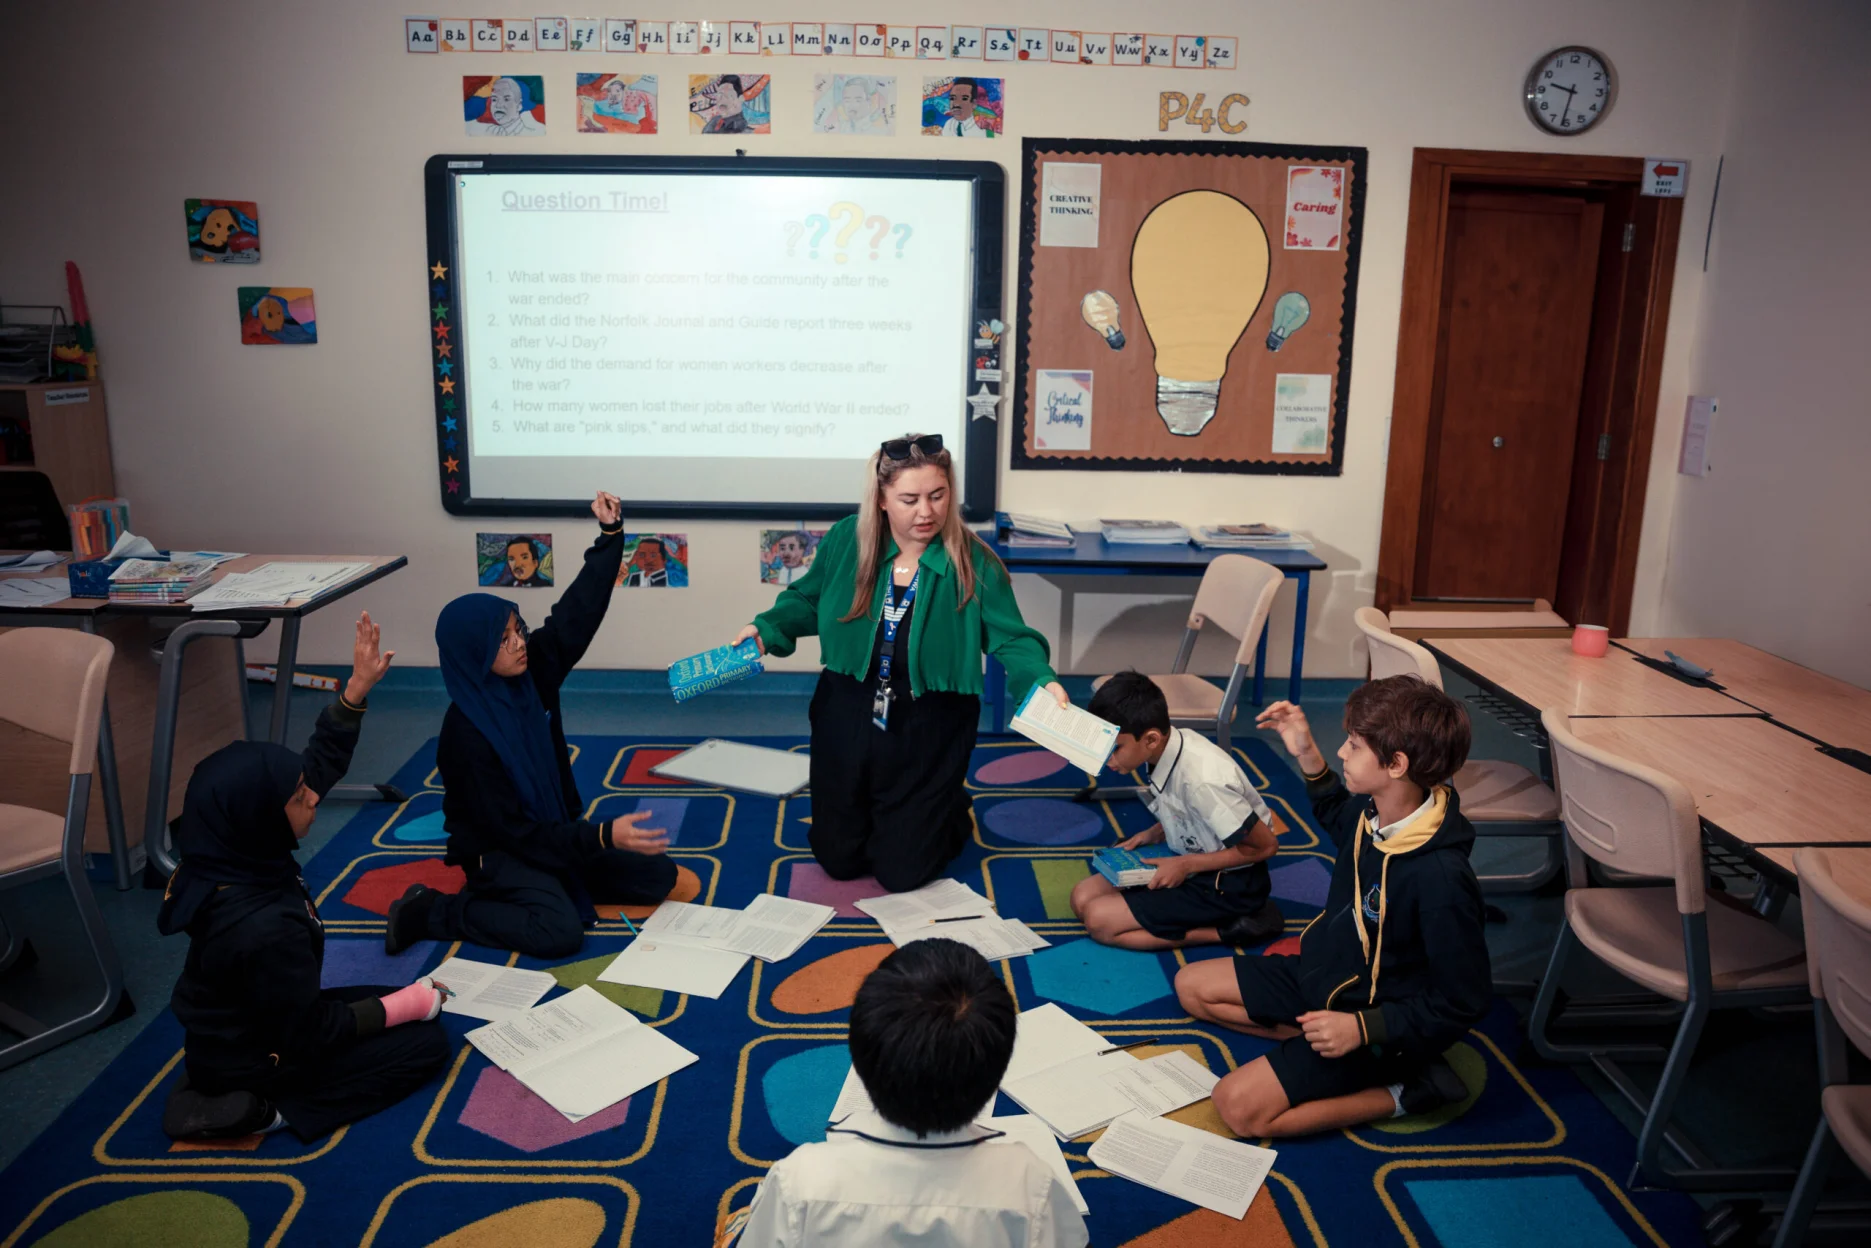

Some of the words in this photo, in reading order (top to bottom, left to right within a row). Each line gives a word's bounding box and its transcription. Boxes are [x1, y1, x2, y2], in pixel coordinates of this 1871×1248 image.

[1159, 91, 1250, 134] P4C
[502, 191, 600, 211] Question
[609, 192, 668, 210] Time!
[1049, 195, 1093, 203] CREATIVE
[1049, 206, 1093, 215] THINKING
[1293, 201, 1337, 215] Caring
[486, 271, 499, 284] 1.
[508, 271, 545, 284] What
[549, 273, 576, 284] was
[580, 271, 602, 284] the
[607, 272, 640, 284] main
[704, 272, 723, 284] for
[726, 273, 748, 285] the
[752, 273, 828, 289] community
[832, 274, 863, 287] after
[867, 275, 889, 287] the
[508, 295, 534, 305] war
[538, 292, 590, 305] ended?
[487, 315, 499, 327] 2.
[509, 314, 546, 327] What
[550, 314, 570, 327] did
[575, 314, 596, 327] the
[600, 314, 649, 327] Norfolk
[653, 315, 704, 328] Journal
[709, 316, 734, 328] and
[738, 316, 780, 329] Guide
[784, 318, 825, 332] report
[829, 318, 864, 330] three
[868, 318, 912, 331] weeks
[510, 336, 541, 348] after
[545, 336, 568, 348] V-J
[572, 336, 607, 351] Day?
[489, 358, 501, 370] 3.
[510, 357, 542, 373] Why
[546, 357, 566, 370] did
[570, 358, 592, 370] the
[596, 358, 651, 370] demand
[656, 358, 674, 370] for
[679, 360, 728, 371] women
[731, 360, 786, 372] workers
[789, 360, 853, 373] decrease
[857, 361, 888, 373] after
[512, 379, 533, 391] the
[537, 379, 570, 391] war?
[491, 401, 503, 412] 4.
[513, 400, 547, 412] How
[548, 402, 585, 415] many
[589, 402, 638, 412] women
[642, 400, 666, 412] lost
[670, 400, 699, 413] their
[703, 401, 732, 416] jobs
[736, 401, 767, 414] after
[770, 401, 810, 414] World
[814, 402, 842, 415] War
[846, 403, 855, 415] II
[859, 402, 910, 416] ended?
[492, 421, 504, 433] 5.
[513, 420, 549, 433] What
[553, 423, 576, 433] are
[579, 421, 613, 436] "pink
[661, 421, 686, 434] and
[690, 421, 723, 434] what
[726, 422, 747, 434] did
[751, 422, 780, 437] they
[784, 422, 836, 438] signify?
[677, 677, 721, 701] OXFORD
[720, 664, 752, 680] PRIMARY
